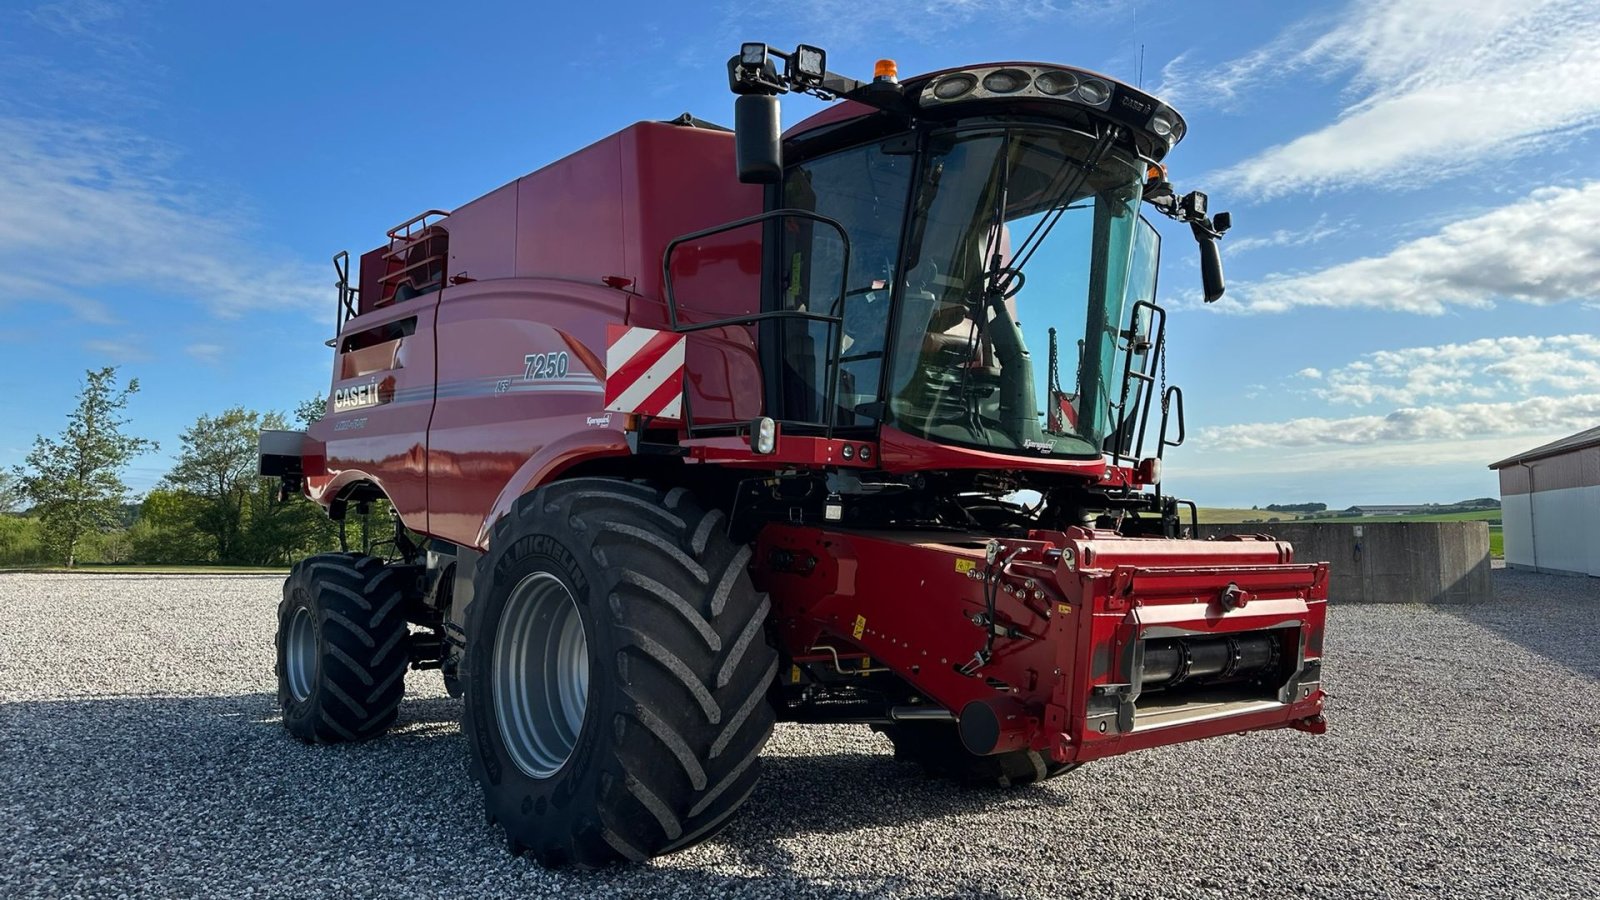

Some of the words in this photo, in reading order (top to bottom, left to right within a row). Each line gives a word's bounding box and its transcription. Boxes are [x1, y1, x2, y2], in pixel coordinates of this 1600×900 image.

[524, 351, 568, 381] 7250
[335, 385, 366, 408] CASE
[514, 535, 587, 590] MICHELIN
